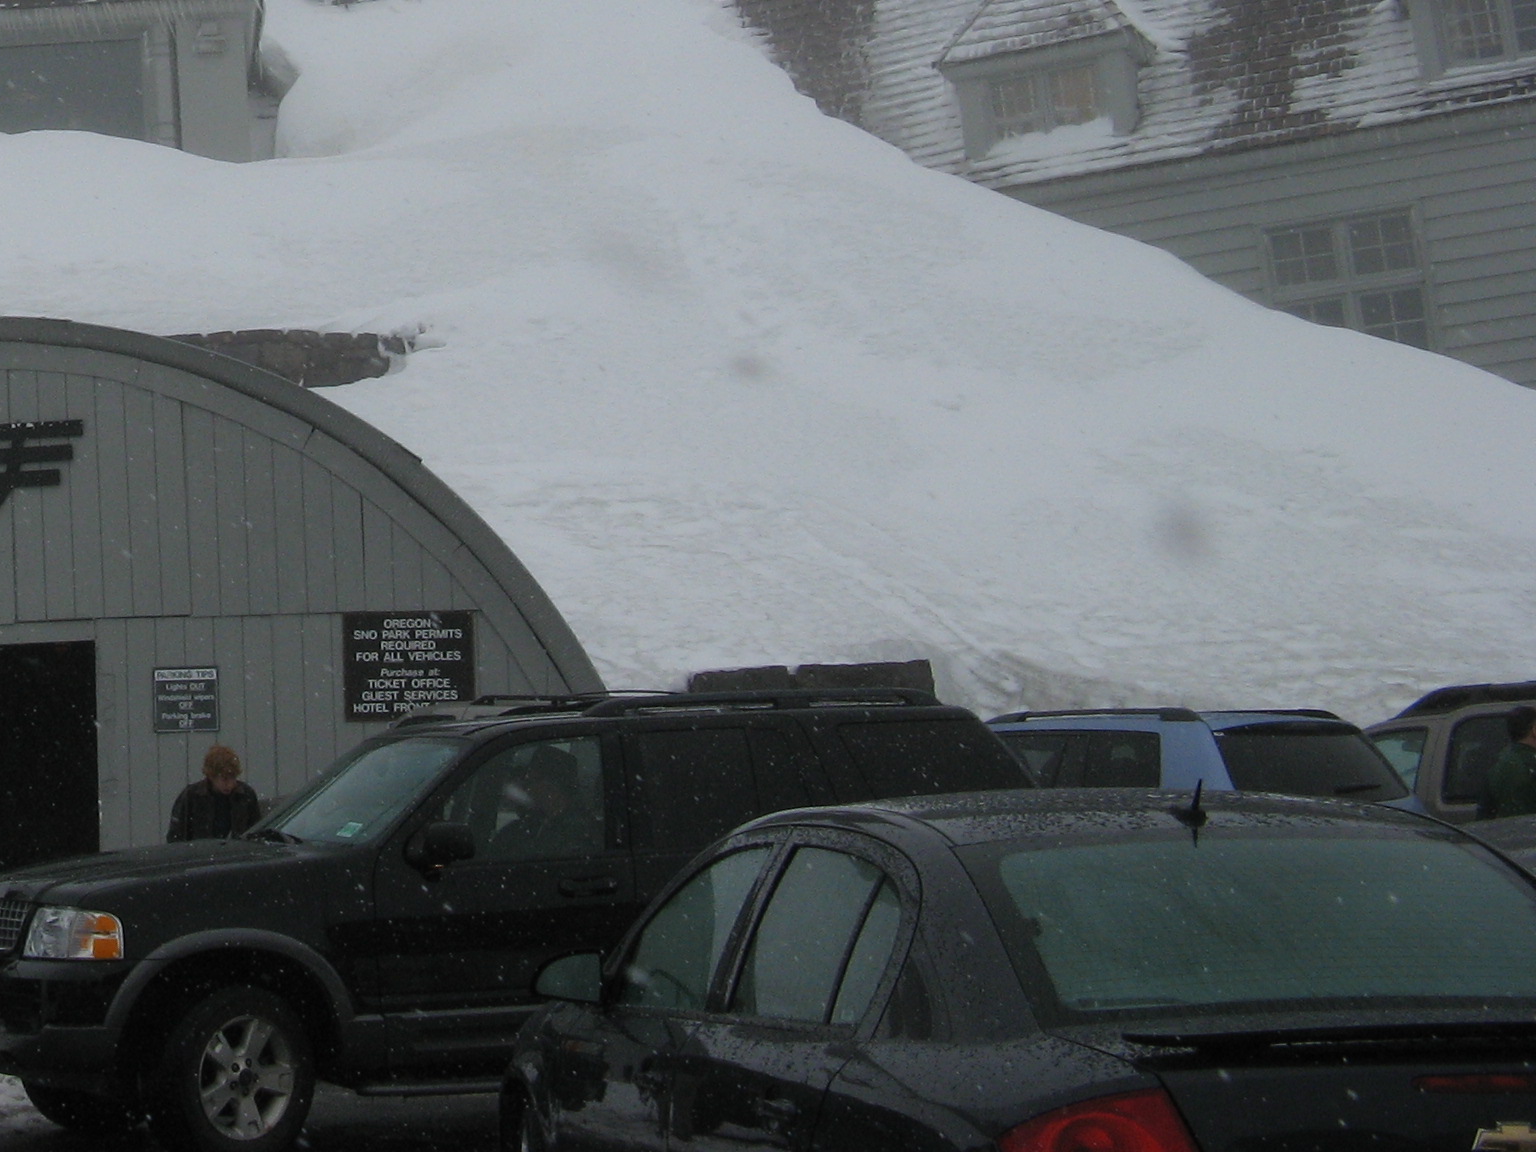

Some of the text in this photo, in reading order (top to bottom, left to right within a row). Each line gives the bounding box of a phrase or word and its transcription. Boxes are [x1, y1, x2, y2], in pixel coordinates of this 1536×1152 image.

[383, 618, 431, 629] OREGON
[353, 628, 462, 640] SNO PARK PERMITS
[380, 640, 436, 651] REQUIRED
[356, 650, 462, 662] FOR ALL VEHICLES
[156, 670, 214, 680] PARKING TIPS
[380, 668, 441, 677] Purchase at:
[165, 682, 206, 691] Lights OUT
[368, 678, 451, 689] TICKET OFFICE
[362, 690, 459, 701] GUEST SERVICES
[353, 703, 389, 713] HOTEL
[161, 712, 189, 720] Parking
